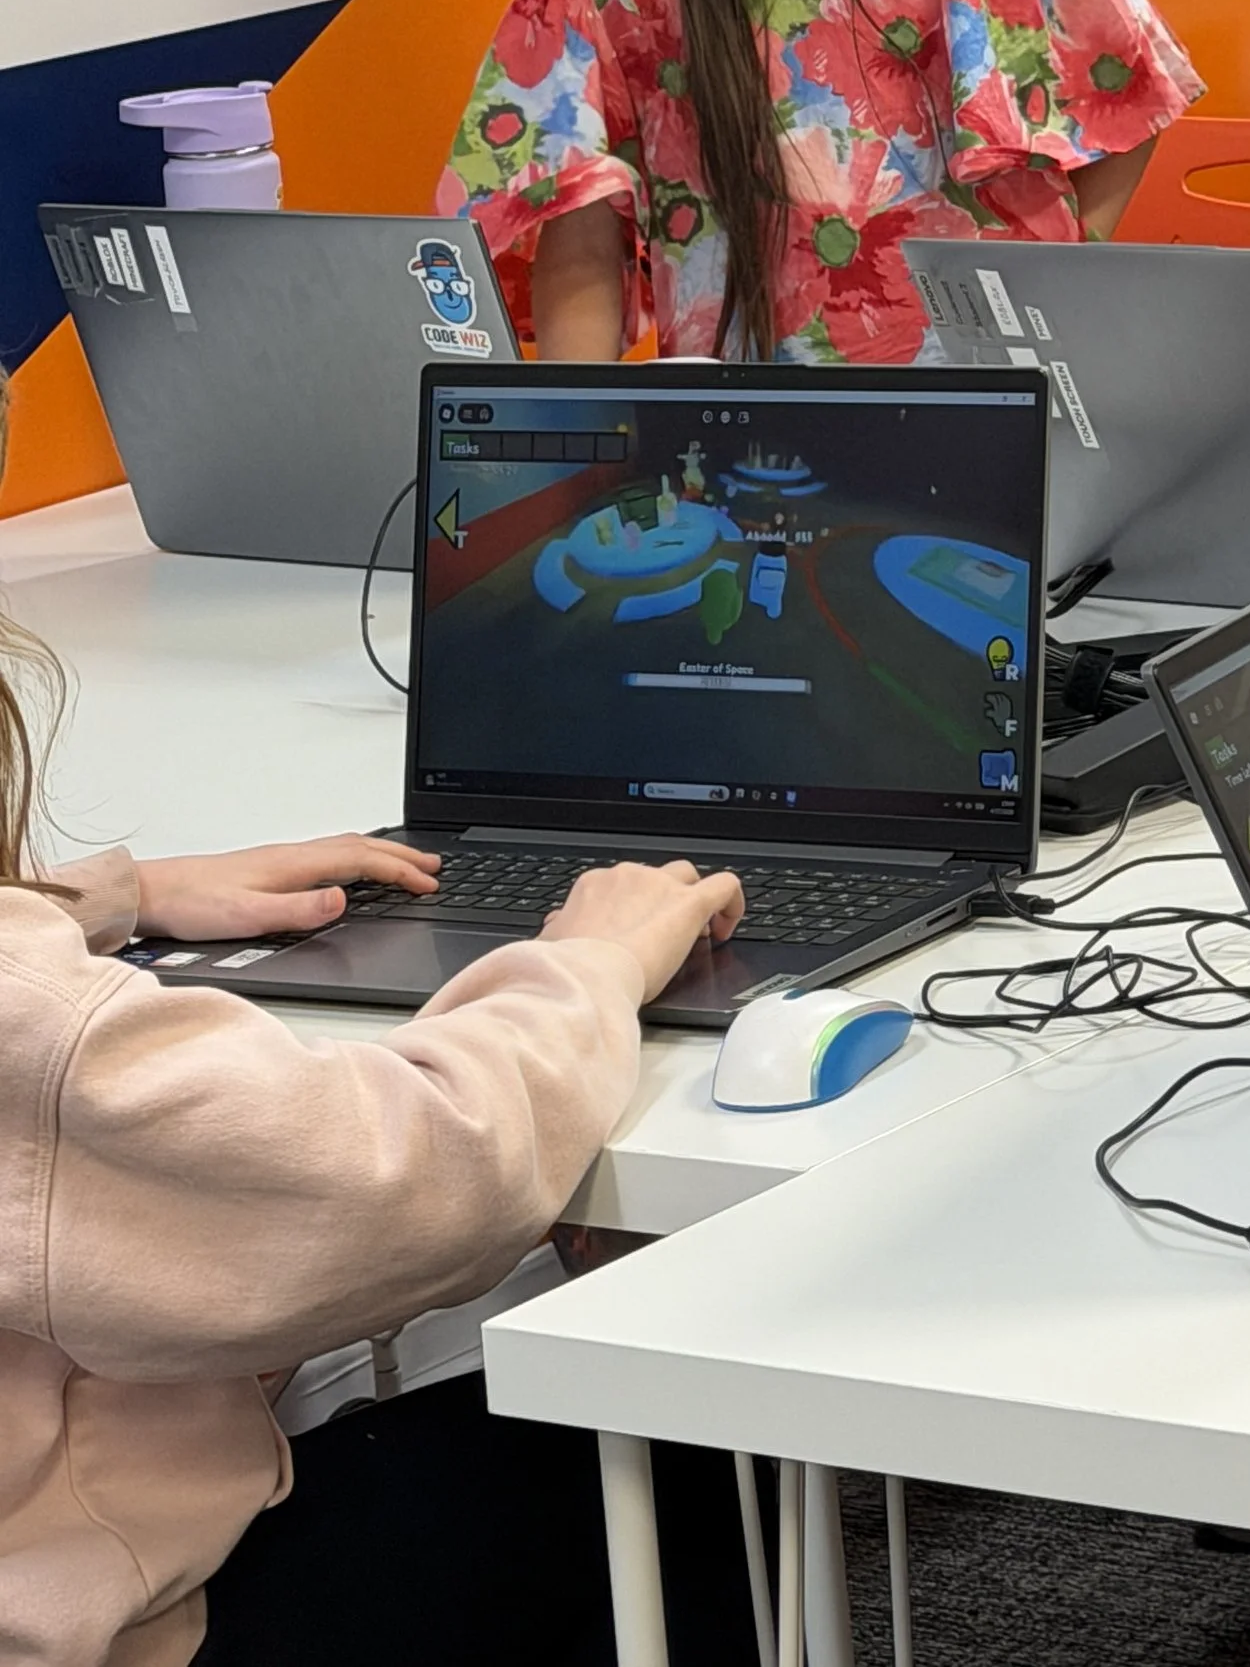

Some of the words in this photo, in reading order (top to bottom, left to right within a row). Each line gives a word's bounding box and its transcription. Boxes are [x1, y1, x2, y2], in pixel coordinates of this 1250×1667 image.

[919, 275, 945, 322] Lenovo
[424, 326, 459, 345] CODE
[459, 330, 489, 349] WIZ
[1055, 364, 1079, 407] SCREEN
[1072, 407, 1095, 444] TOUCH
[446, 441, 480, 455] Tasks
[453, 530, 469, 550] T
[679, 662, 711, 674] Easter
[712, 663, 724, 674] of
[725, 663, 754, 675] Space
[1005, 665, 1019, 681] R
[1004, 719, 1018, 736] F
[1210, 741, 1238, 765] Tasks
[1001, 775, 1019, 793] M
